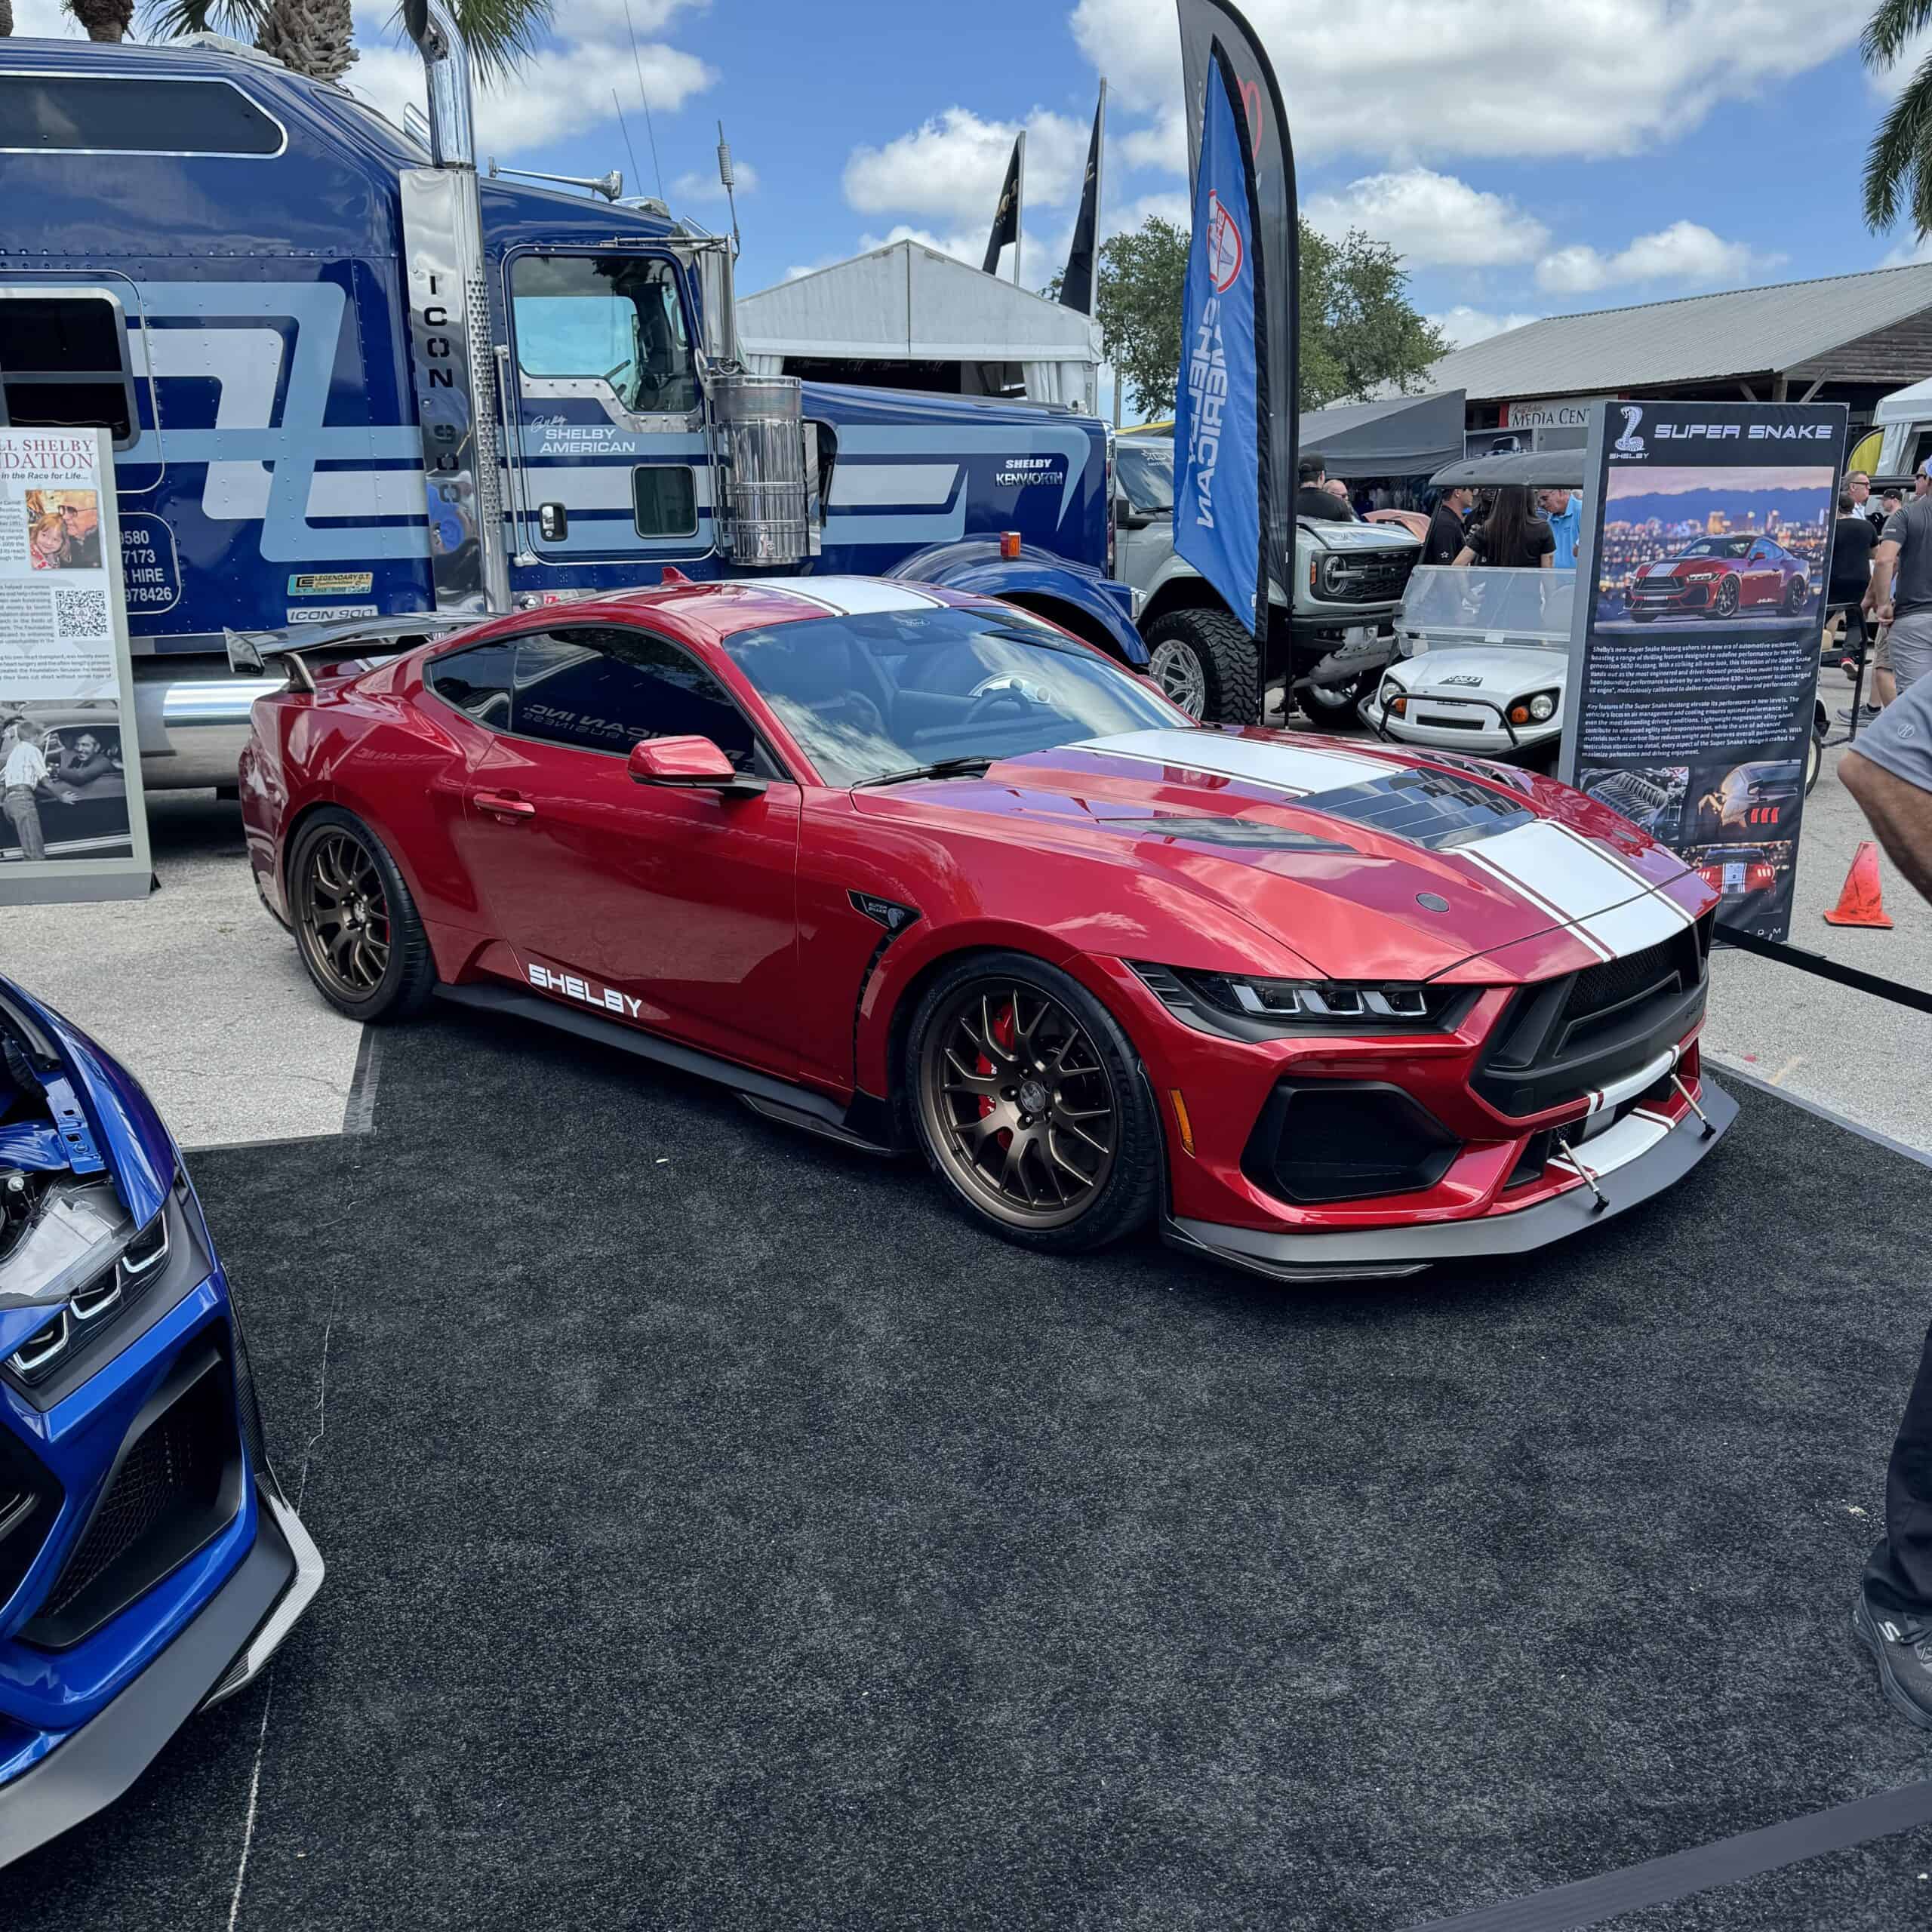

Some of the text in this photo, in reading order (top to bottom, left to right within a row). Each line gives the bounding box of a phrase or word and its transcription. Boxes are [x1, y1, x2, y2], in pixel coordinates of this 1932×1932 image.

[423, 275, 454, 389] ICON
[1512, 411, 1554, 426] MEDIA
[546, 429, 617, 440] SHELBY
[1654, 424, 1833, 439] SUPER SNAKE
[23, 439, 92, 451] SHELBY
[540, 441, 635, 454] AMERICAN
[1005, 458, 1052, 469] SHELBY
[996, 472, 1063, 486] KENWORTH
[122, 549, 156, 564] 7173
[131, 568, 165, 583] HIRE
[291, 611, 334, 620] ICON
[528, 963, 642, 1018] SHELBY
